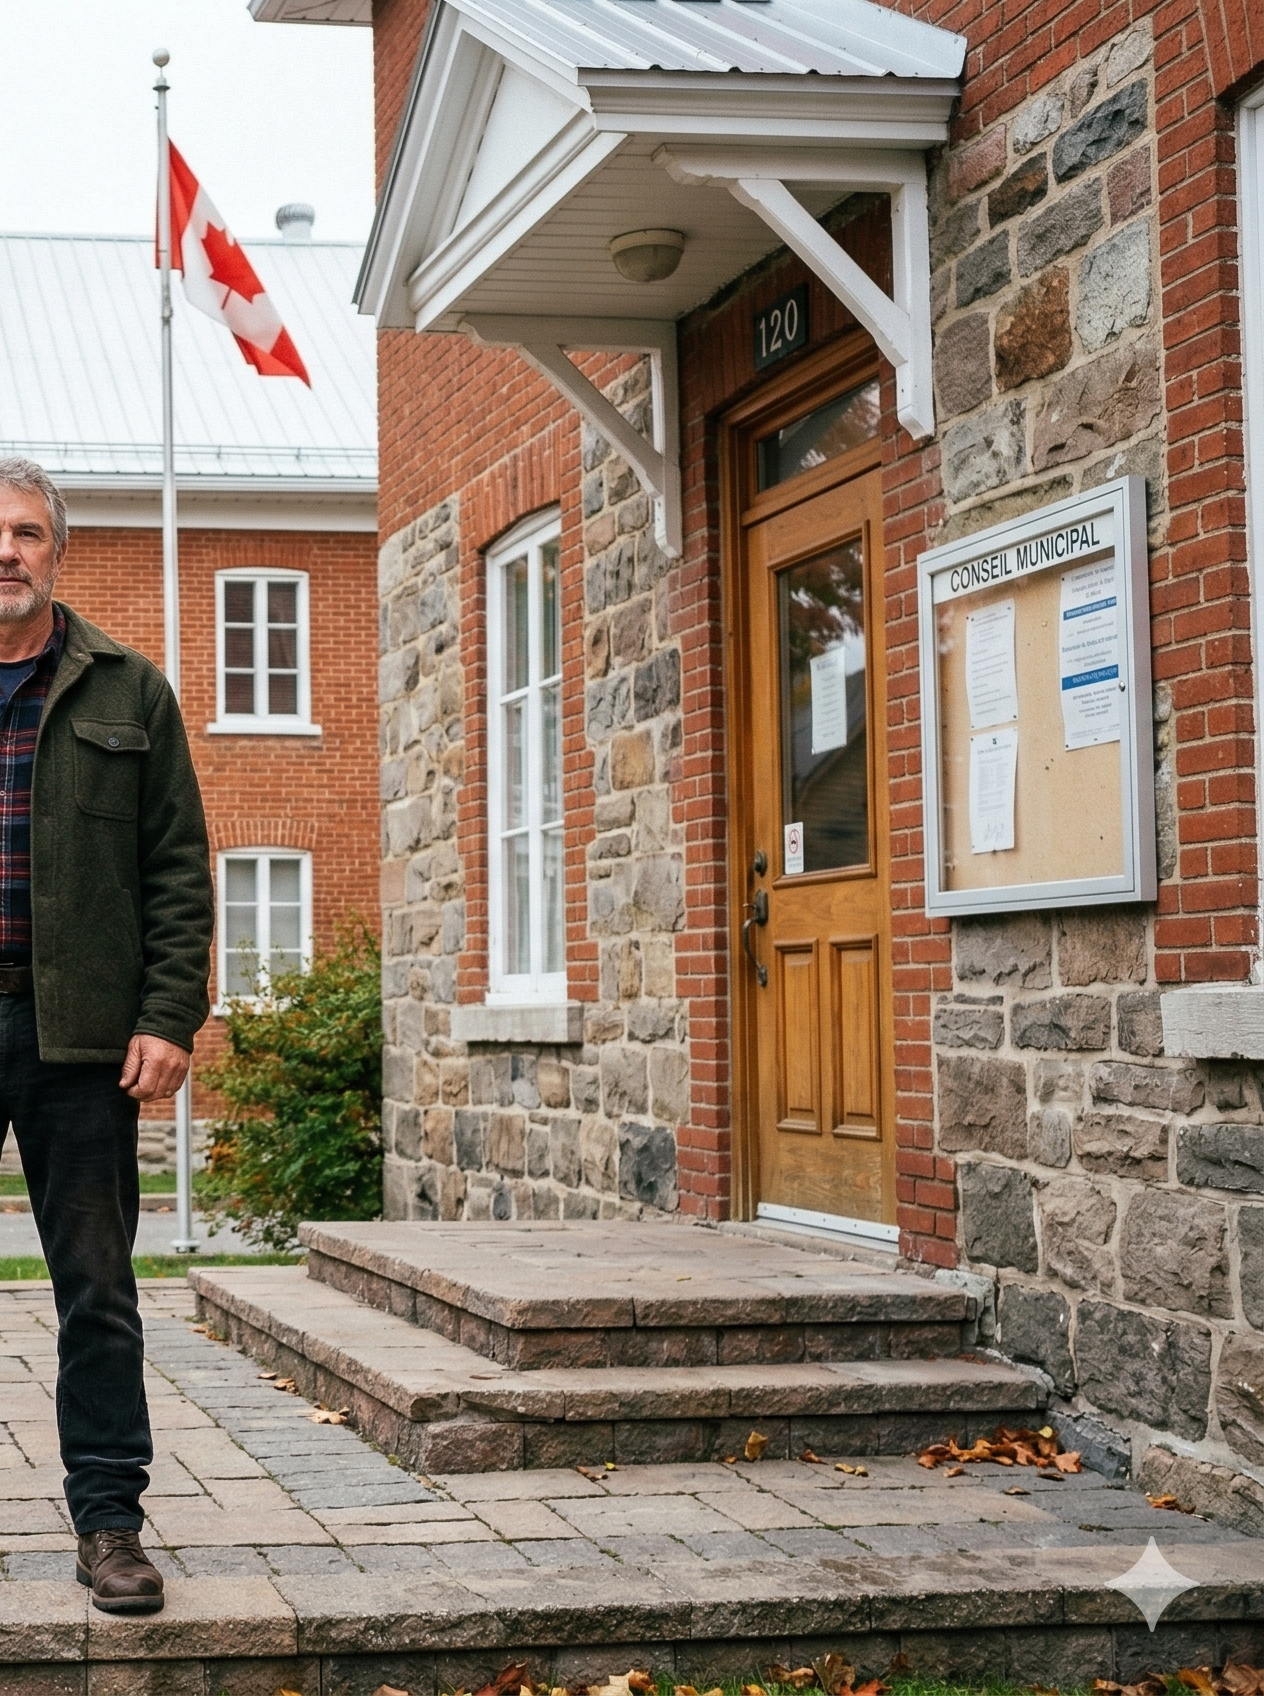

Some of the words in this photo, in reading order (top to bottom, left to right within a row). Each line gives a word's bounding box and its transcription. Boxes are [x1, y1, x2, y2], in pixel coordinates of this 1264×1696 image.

[759, 299, 798, 358] 120
[950, 553, 1012, 592] CONSEIL
[1016, 522, 1100, 571] MUNICIPAL
